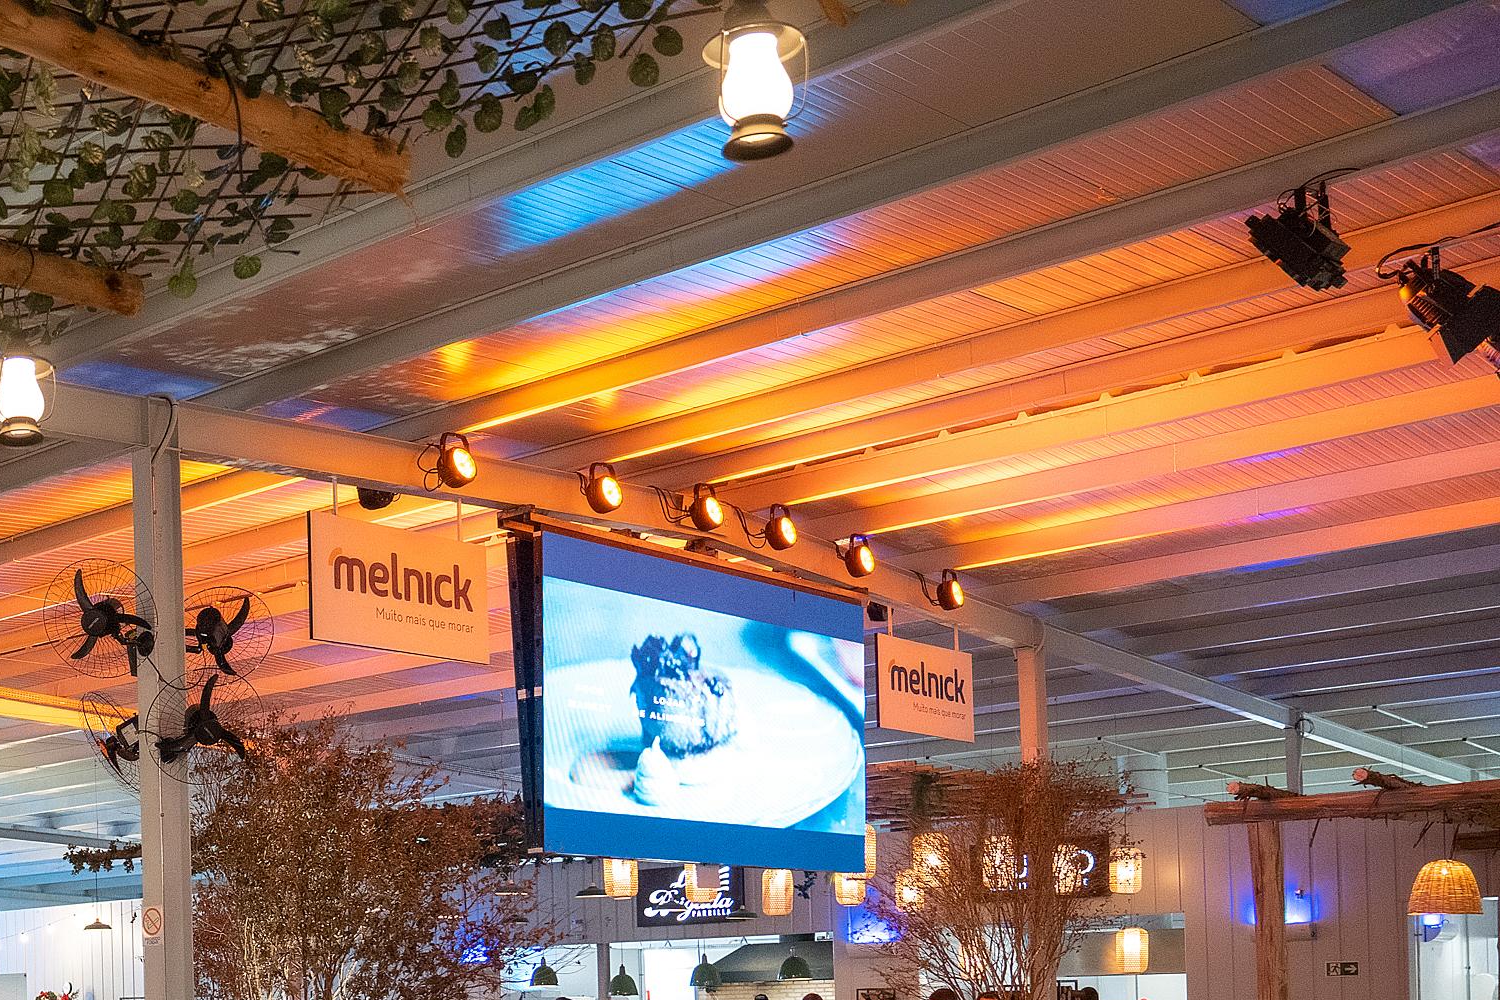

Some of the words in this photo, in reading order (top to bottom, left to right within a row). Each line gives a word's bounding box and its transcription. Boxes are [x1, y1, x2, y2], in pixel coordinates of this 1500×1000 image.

[333, 552, 474, 612] melnick
[375, 607, 403, 623] Muito
[405, 614, 427, 626] mais
[428, 618, 446, 631] que
[448, 622, 474, 633] morar
[890, 661, 966, 704] melnick
[912, 701, 928, 714] Muito
